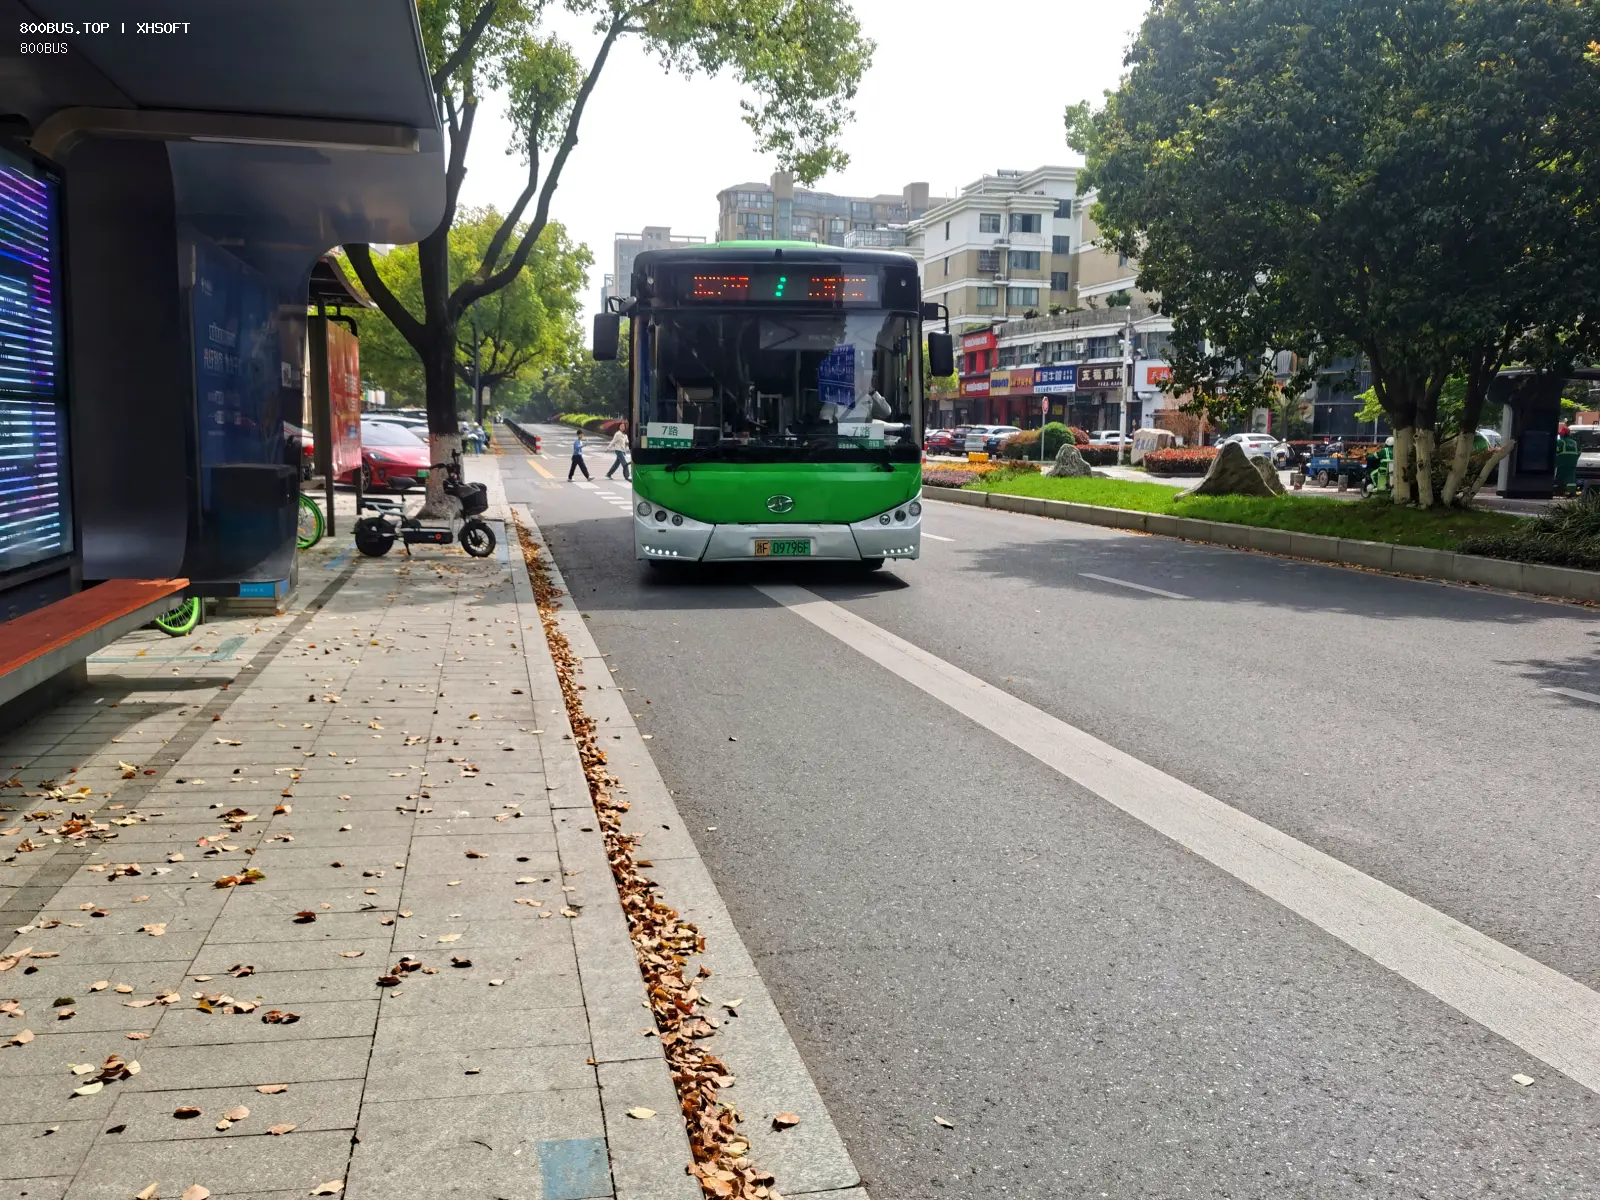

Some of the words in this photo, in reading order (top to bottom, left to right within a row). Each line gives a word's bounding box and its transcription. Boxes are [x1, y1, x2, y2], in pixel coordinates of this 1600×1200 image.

[661, 425, 679, 437] 7路
[852, 426, 871, 438] 7路
[773, 541, 811, 554] 09796F
